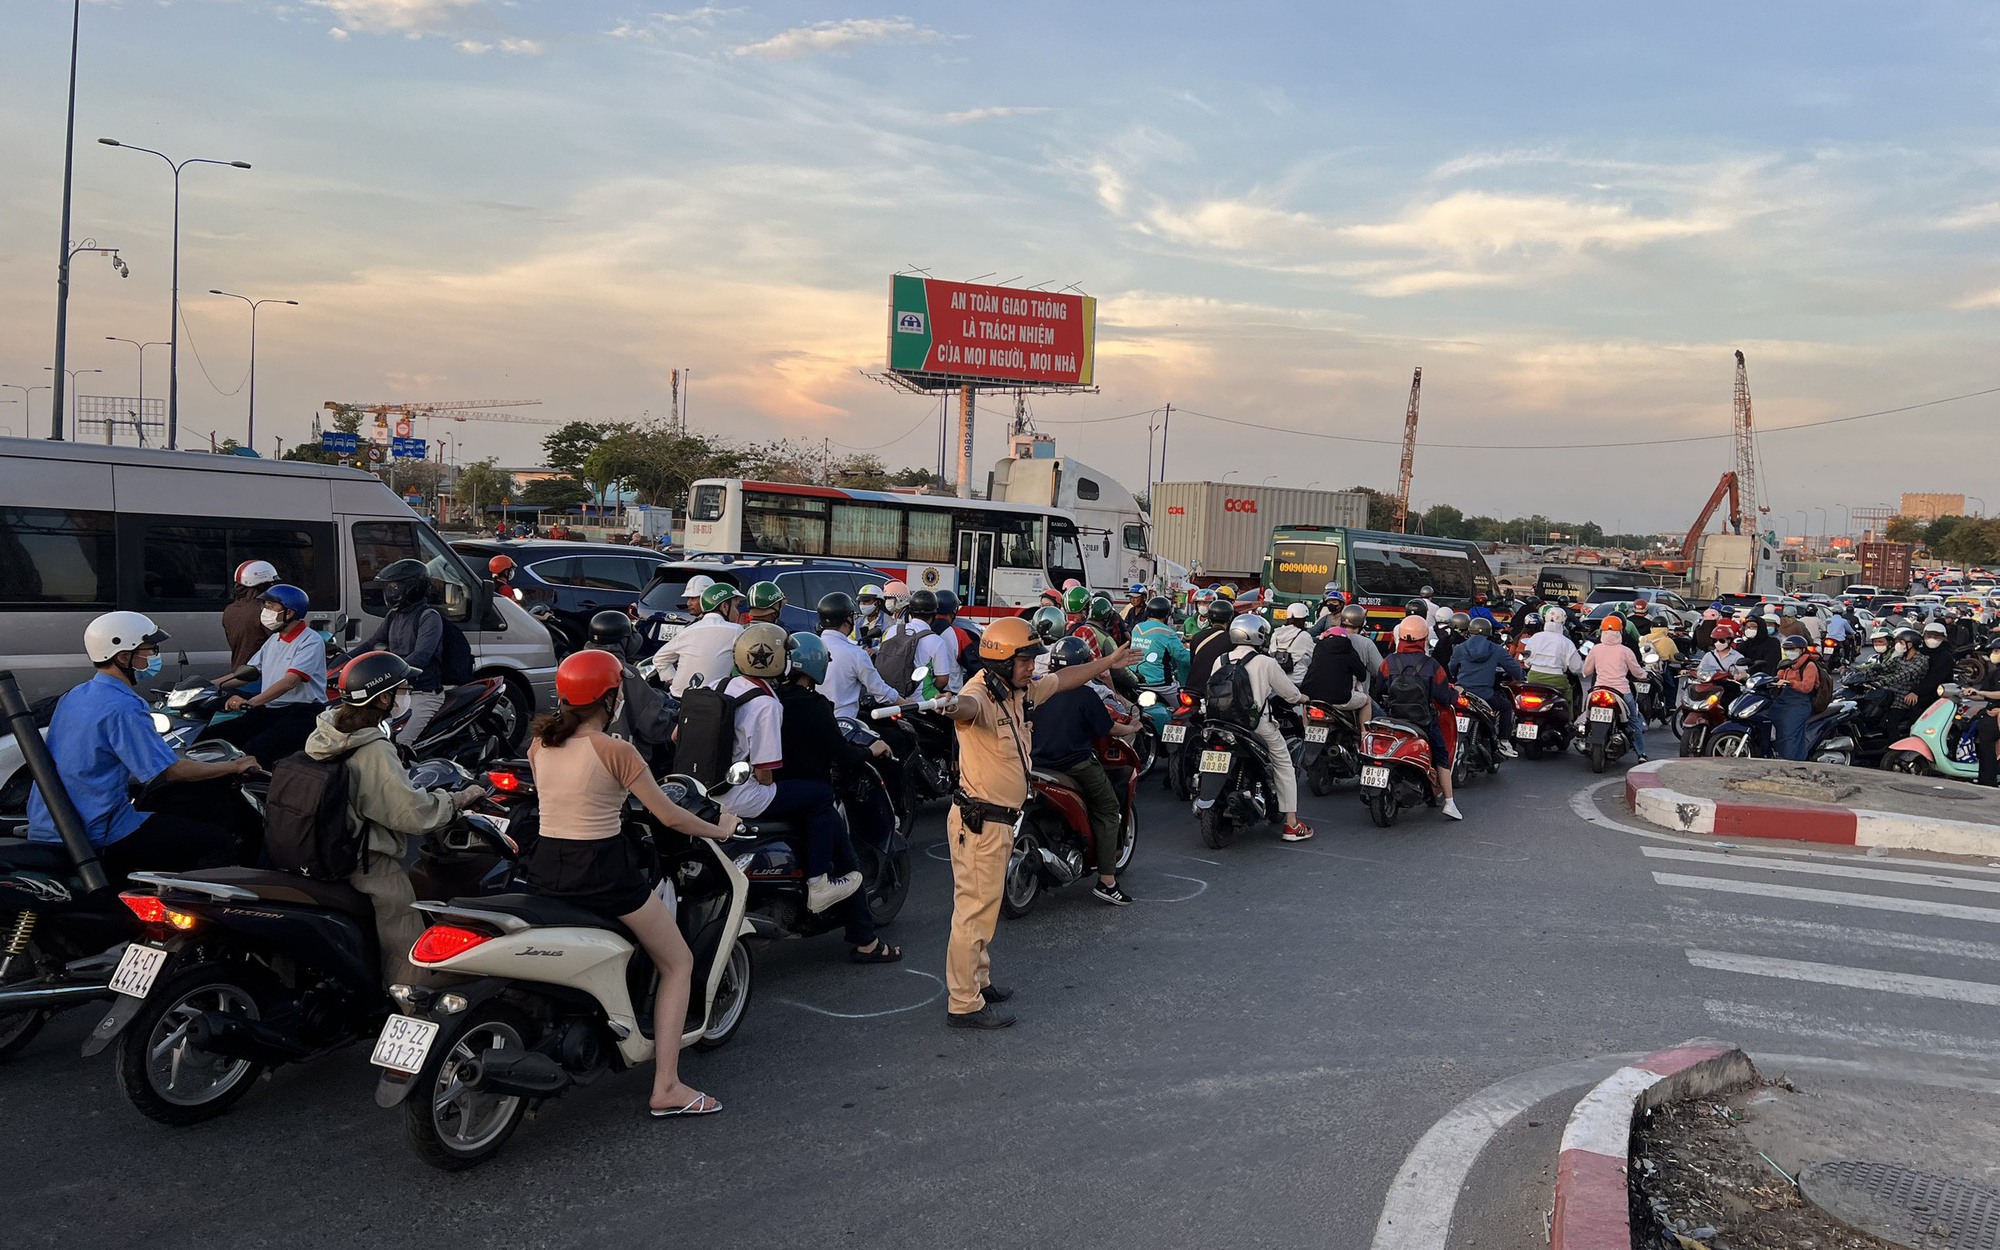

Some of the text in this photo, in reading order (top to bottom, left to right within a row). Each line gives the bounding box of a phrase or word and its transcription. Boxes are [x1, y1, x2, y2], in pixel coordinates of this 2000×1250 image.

[951, 291, 1067, 320] AN TOÀN GIAO THÔNG
[963, 316, 1054, 348] LÀ TRÁCH NHIỆM
[938, 340, 1076, 374] CỦA MỌI NGƯỜI, MỌI NHÀ
[964, 388, 974, 457] 0982 456 686
[1867, 551, 1878, 559] tex
[712, 589, 728, 601] Grab
[1201, 761, 1227, 772] 803.86
[1205, 752, 1226, 762] 36-B3
[1363, 776, 1386, 787] 100.59
[126, 948, 158, 972] 74-C1
[515, 946, 564, 956] Janus
[114, 968, 151, 994] 447.44
[390, 1019, 429, 1046] 59-Z2
[378, 1040, 424, 1069] 131.27
